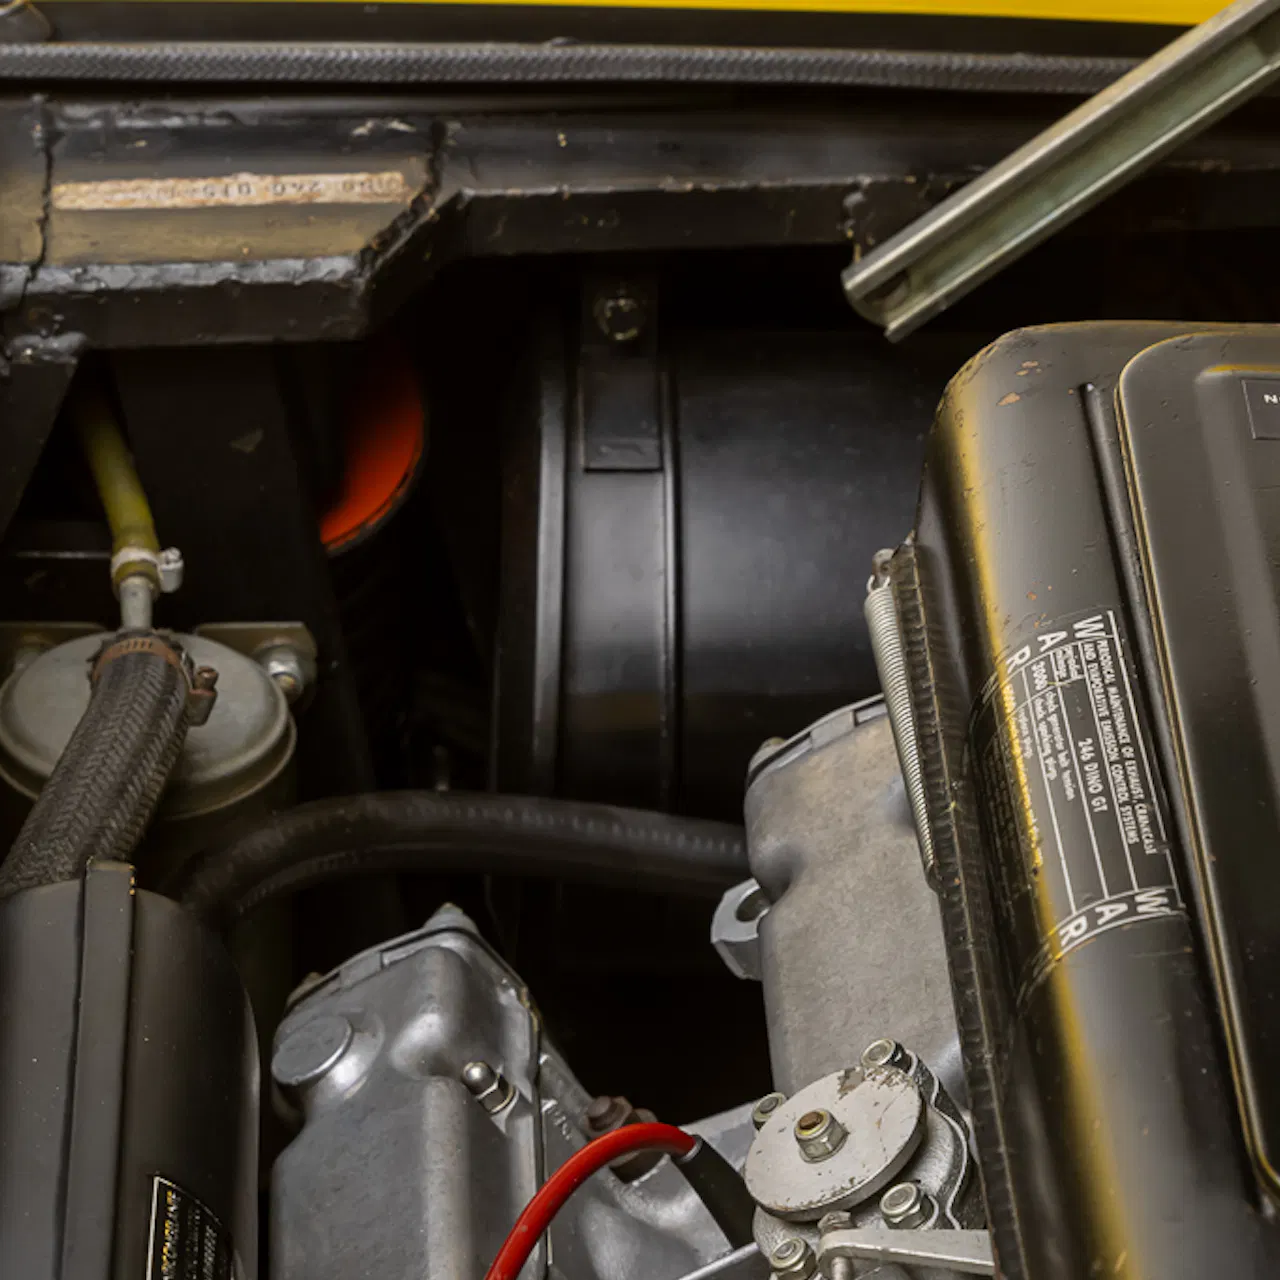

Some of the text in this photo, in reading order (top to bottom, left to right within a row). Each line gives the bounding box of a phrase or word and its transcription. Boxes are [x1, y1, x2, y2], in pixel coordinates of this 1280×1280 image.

[1097, 640, 1115, 685] PERIODICAL
[1109, 687, 1129, 744] MAINTENANCE
[1083, 642, 1139, 845] AND EVAPORATIVE EMISSION CONTROL SYSTEMS
[1123, 745, 1132, 757] OF
[1078, 738, 1107, 813] 246 DINO GT
[1125, 759, 1144, 803] EXHAUST,
